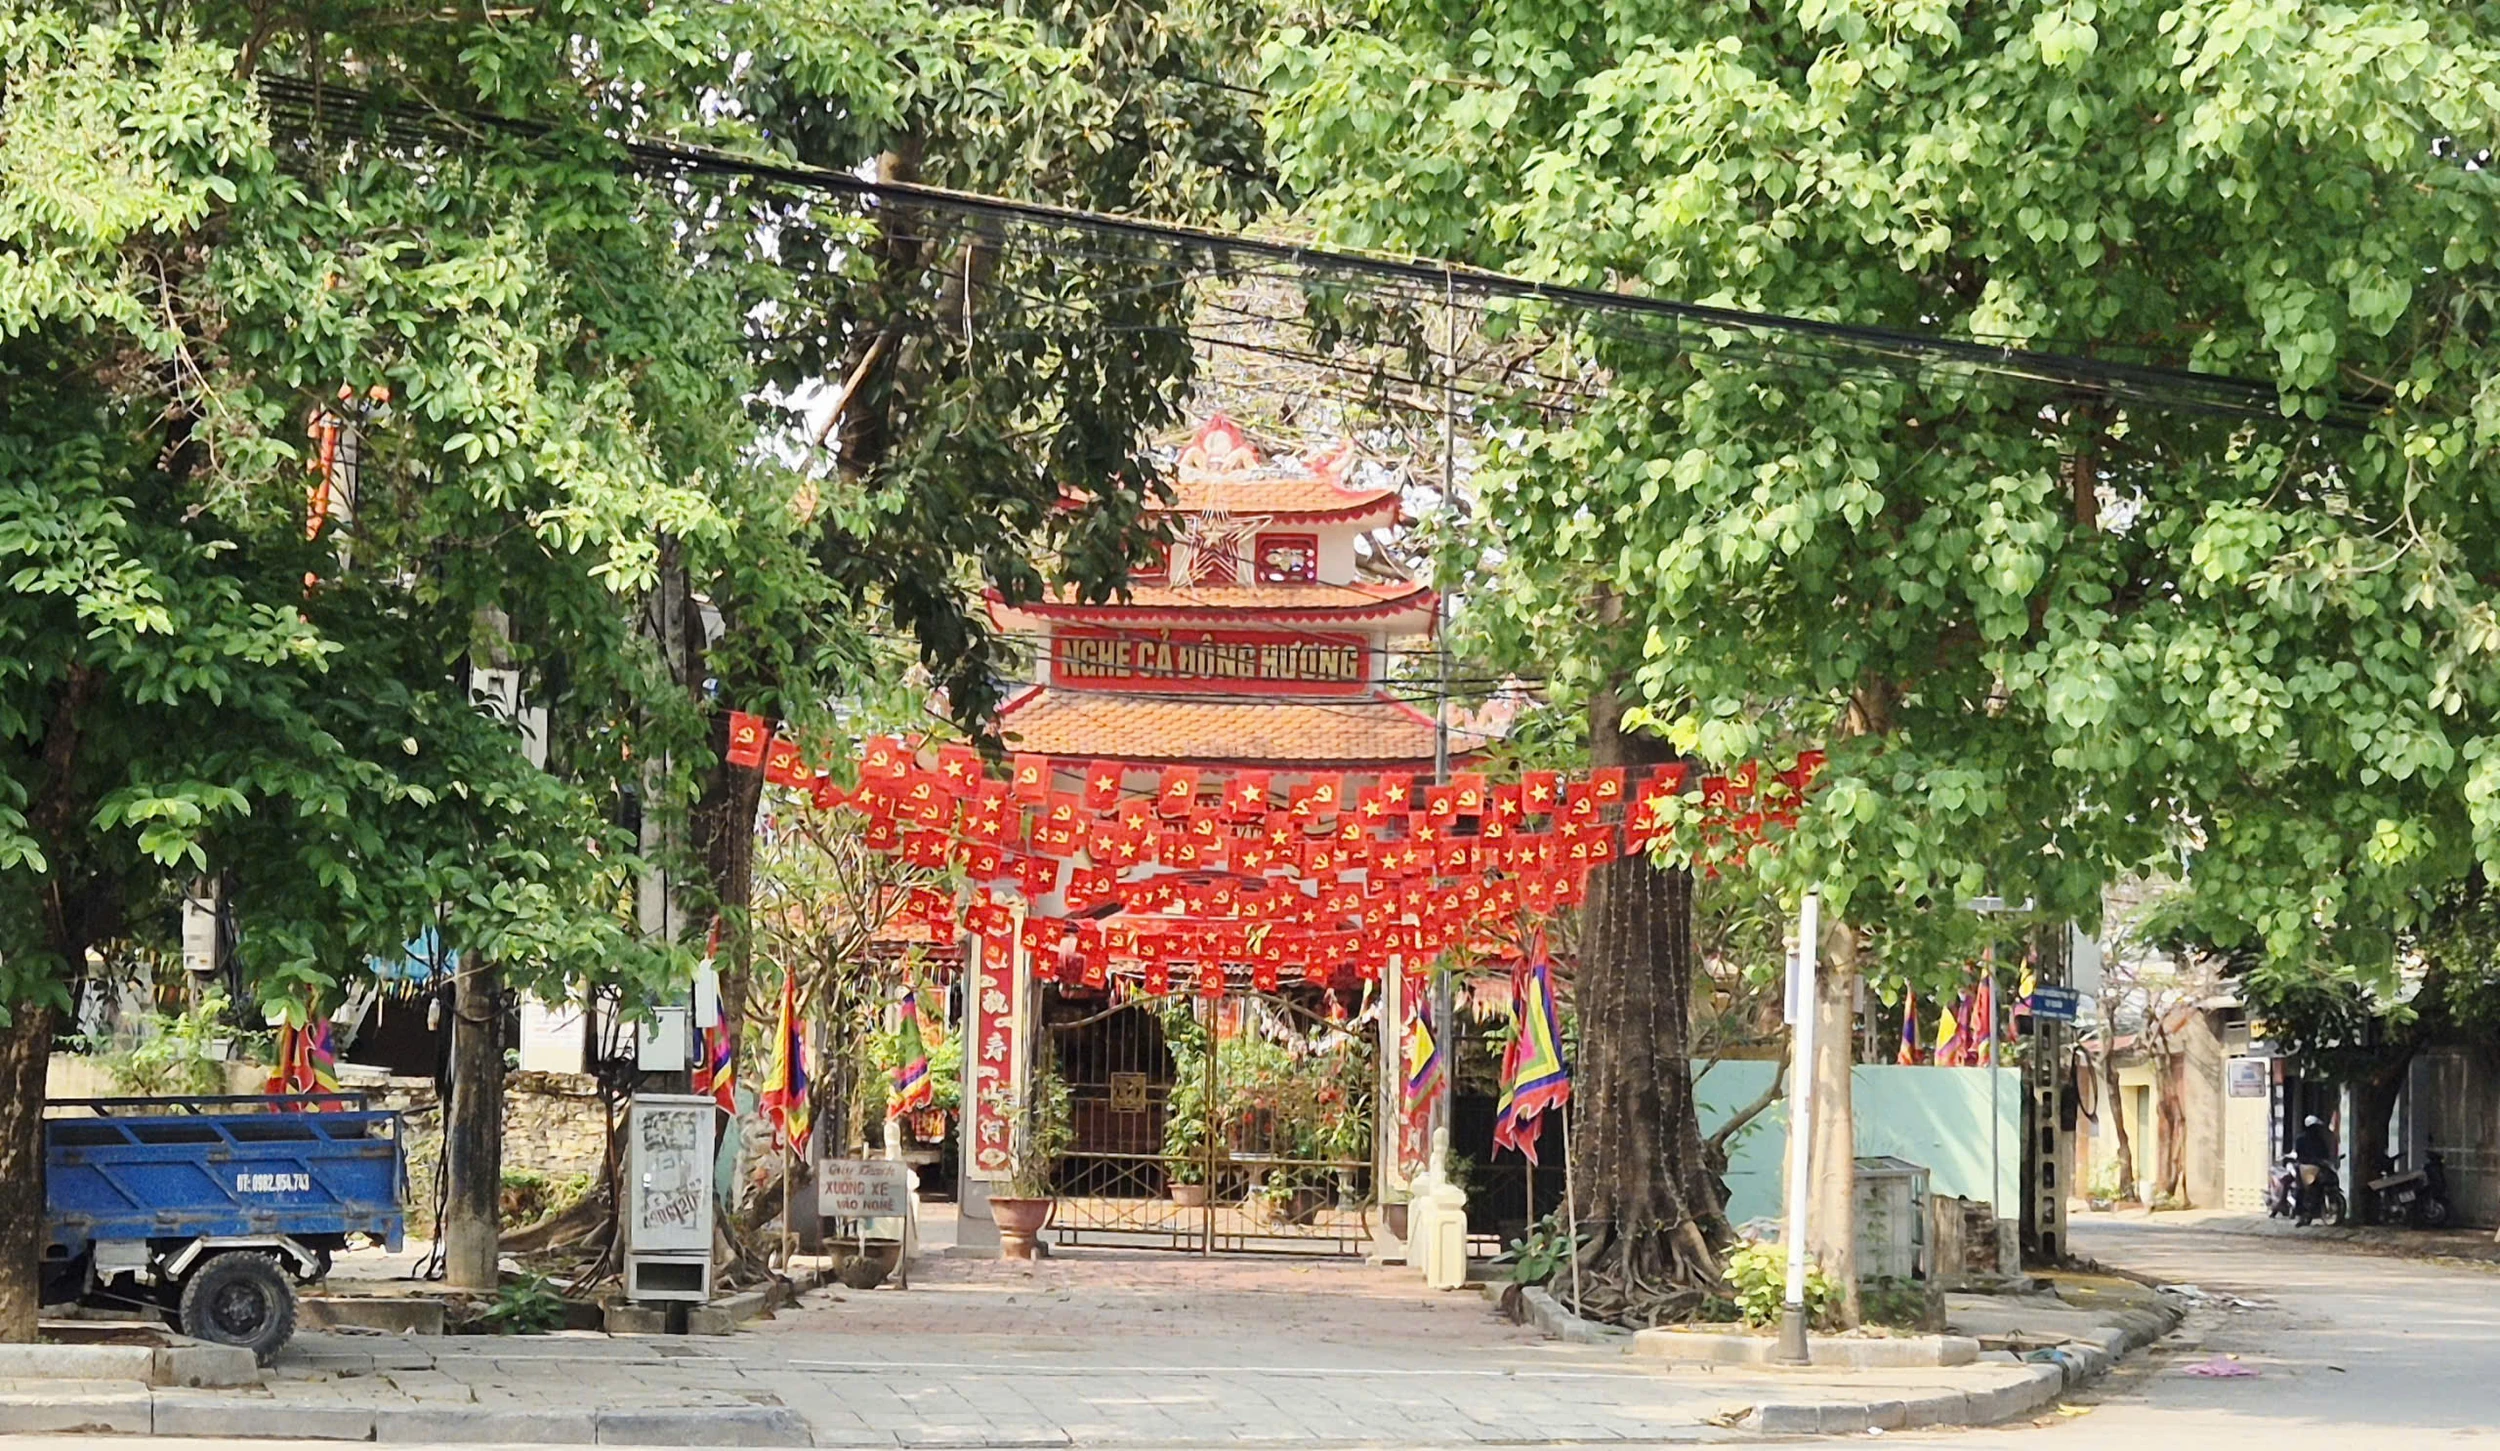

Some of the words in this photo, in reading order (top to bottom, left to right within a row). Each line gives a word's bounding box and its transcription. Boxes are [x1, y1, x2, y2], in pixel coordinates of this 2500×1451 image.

[1137, 627, 1174, 678] CẢ
[1178, 633, 1256, 679] ĐÔNG
[1260, 639, 1359, 681] HƯƠNG
[871, 1182, 889, 1196] XE
